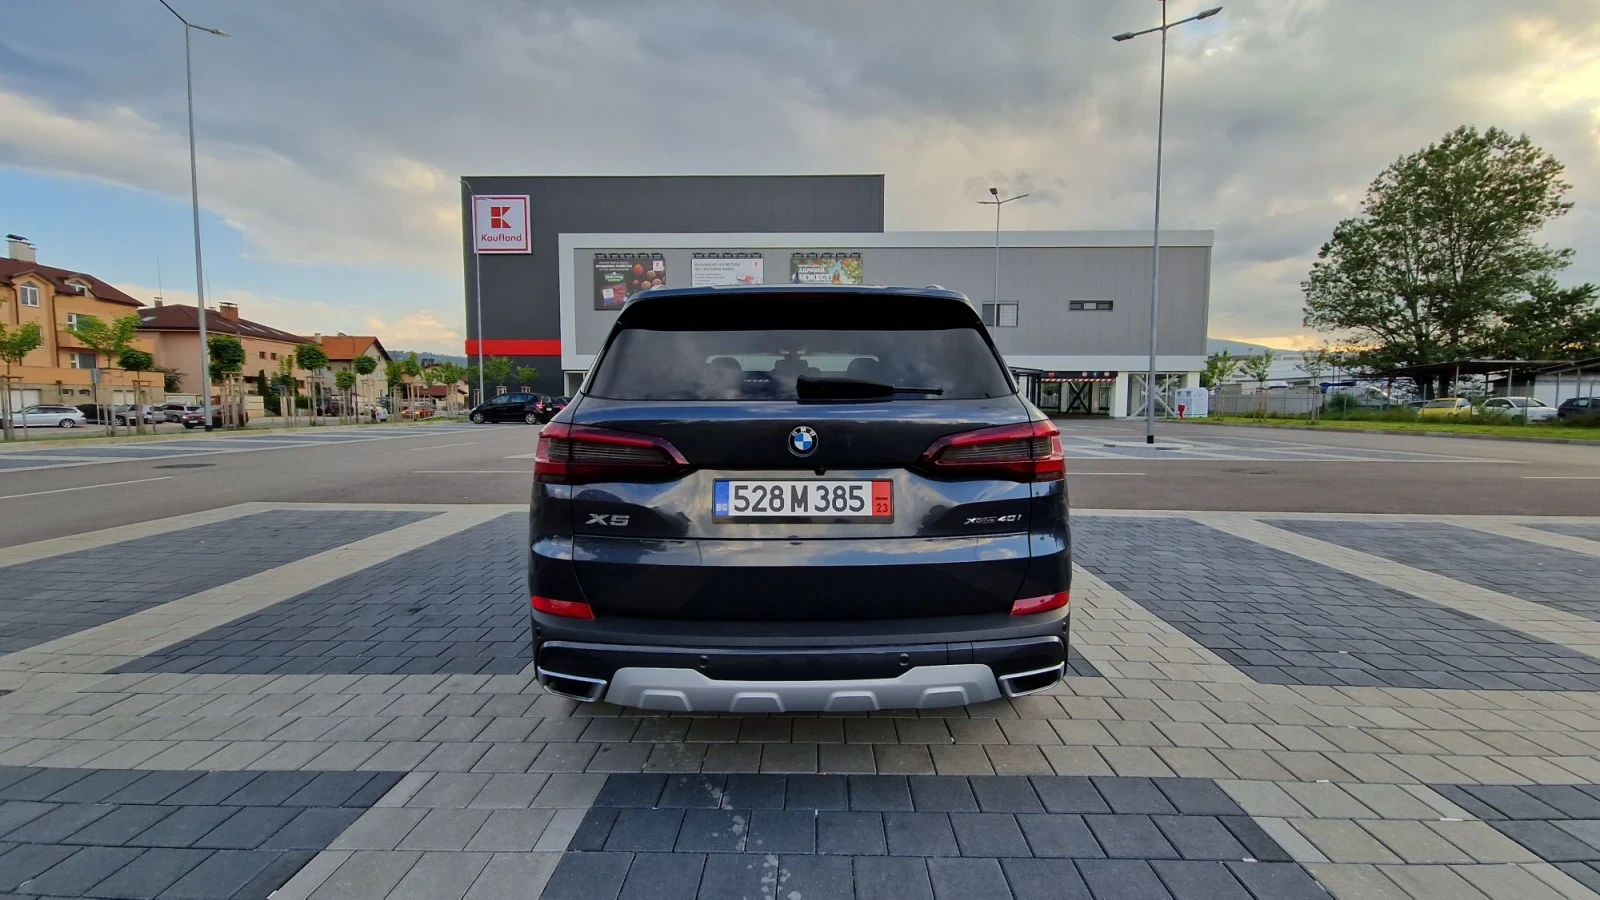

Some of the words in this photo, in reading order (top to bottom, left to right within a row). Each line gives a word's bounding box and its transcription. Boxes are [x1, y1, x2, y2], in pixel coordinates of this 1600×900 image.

[481, 233, 522, 242] Kaufland
[734, 485, 785, 513] 528
[790, 485, 809, 513] M
[814, 485, 865, 513] 385
[715, 503, 728, 512] BG
[876, 503, 889, 513] 23
[585, 513, 630, 526] X5
